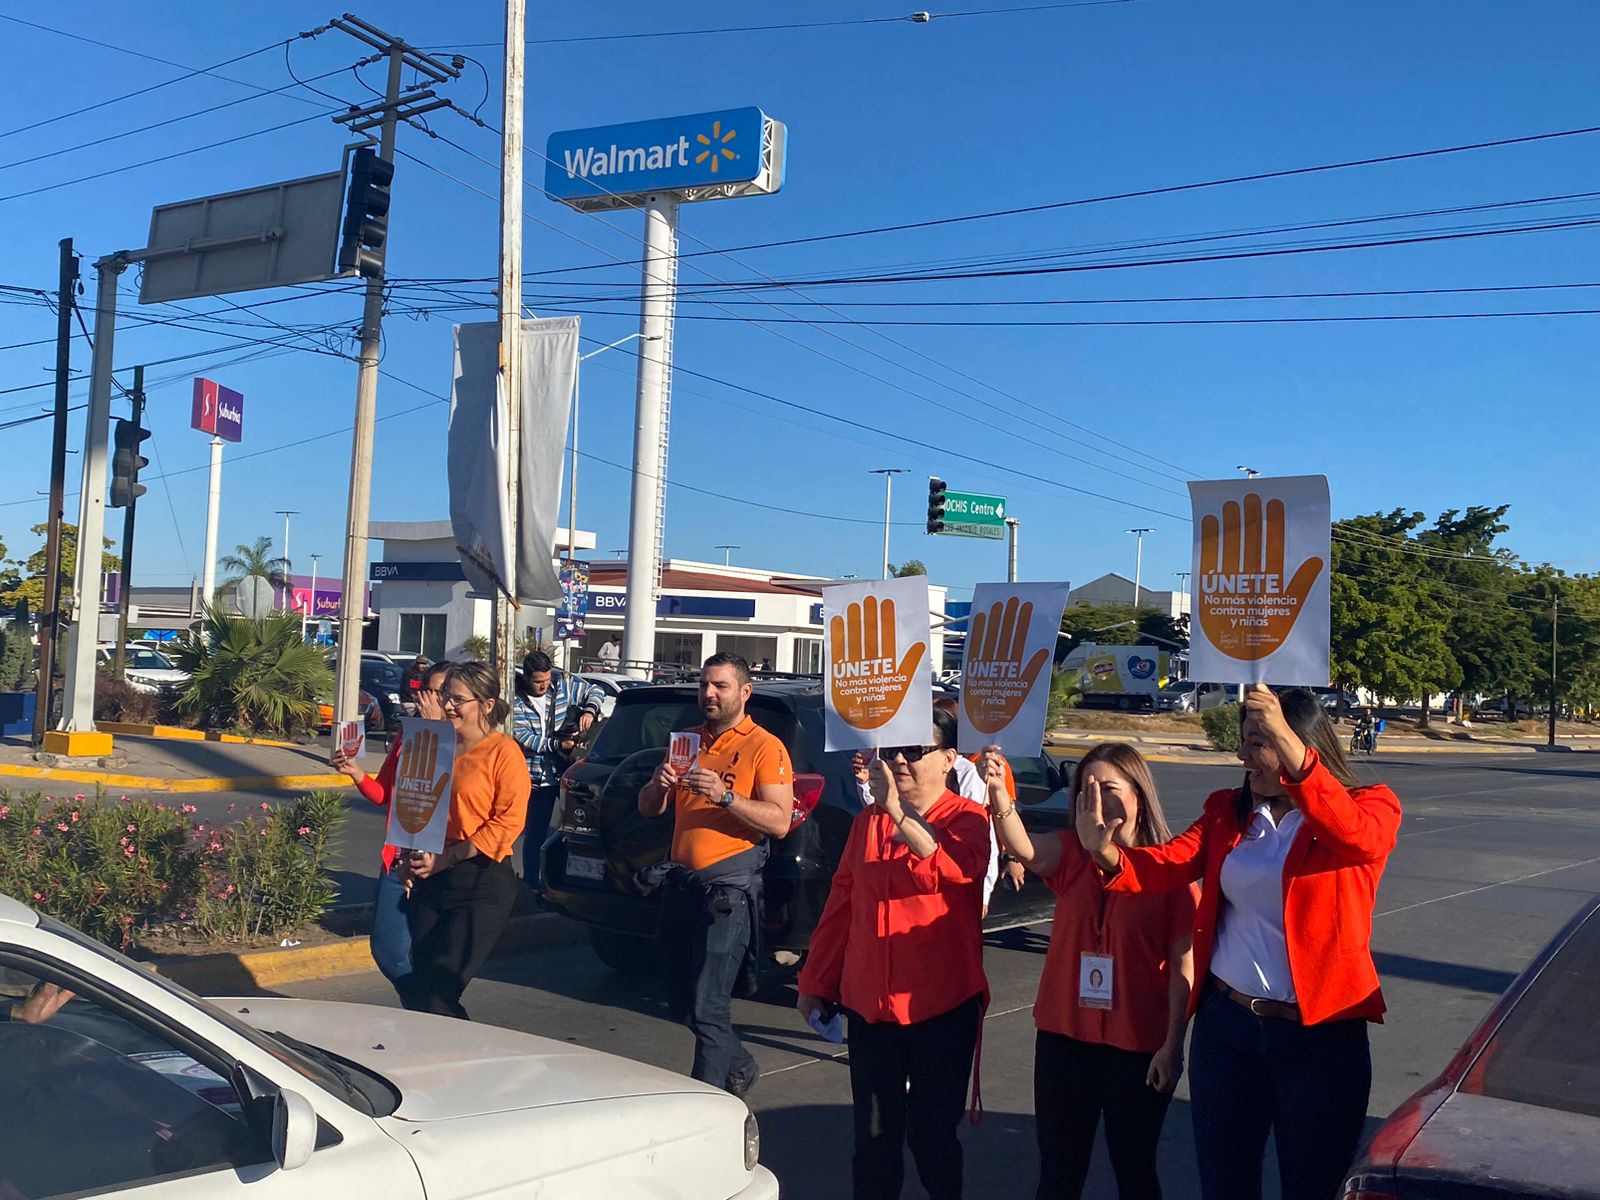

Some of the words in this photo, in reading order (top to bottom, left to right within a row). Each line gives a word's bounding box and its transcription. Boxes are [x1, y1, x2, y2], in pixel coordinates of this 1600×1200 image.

[564, 136, 689, 179] Walmart
[219, 402, 240, 424] Suburbia
[970, 502, 994, 515] Centro
[375, 566, 399, 577] BBVA
[1202, 570, 1279, 594] ÚNETE
[1204, 595, 1220, 605] No
[1222, 595, 1245, 605] más
[1248, 594, 1297, 605] violencia
[1210, 606, 1245, 615] contra
[1247, 606, 1290, 618] mujeres
[1230, 618, 1237, 628] y
[1239, 616, 1269, 627] niñas
[833, 658, 893, 679] ÚNETE
[967, 657, 1019, 678] ÚNETE
[835, 679, 848, 688] No
[849, 677, 867, 686] más
[868, 674, 907, 684] violencia
[968, 678, 977, 687] No
[994, 678, 1028, 688] violencia
[840, 687, 867, 696] contra
[868, 684, 902, 694] mujeres
[992, 688, 1022, 698] mujeres
[856, 696, 861, 704] y
[863, 693, 885, 702] niñas
[986, 697, 1006, 705] niñas
[400, 774, 431, 793] ÚNETE
